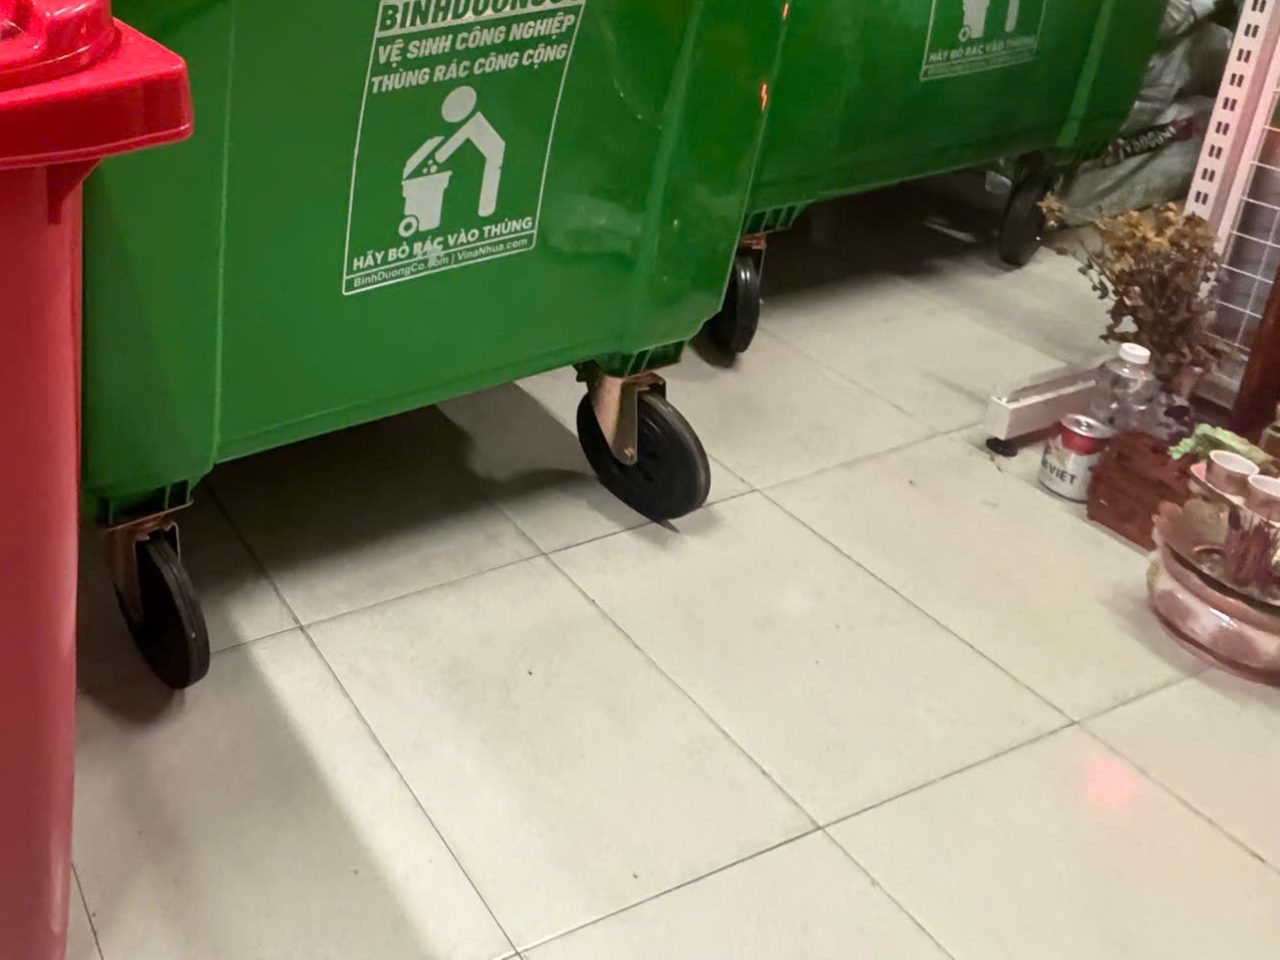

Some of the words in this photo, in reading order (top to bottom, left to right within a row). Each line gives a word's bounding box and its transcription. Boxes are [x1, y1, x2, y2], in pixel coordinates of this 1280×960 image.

[378, 38, 404, 68] VỆ
[406, 34, 453, 60] SINH
[455, 25, 507, 51] CÔNG
[508, 11, 576, 40] NGHIỆP
[370, 67, 430, 94] THÙNG
[432, 58, 471, 82] RÁC
[473, 52, 520, 75] CÔNG
[521, 43, 568, 69] CỘNG
[353, 250, 385, 272] HÃY
[413, 235, 444, 256] RÁC
[448, 228, 479, 247] VÀO
[482, 217, 533, 239] THÙNG
[353, 255, 449, 289] BinhDuongCo.com
[457, 238, 528, 262] VinaNhua.com
